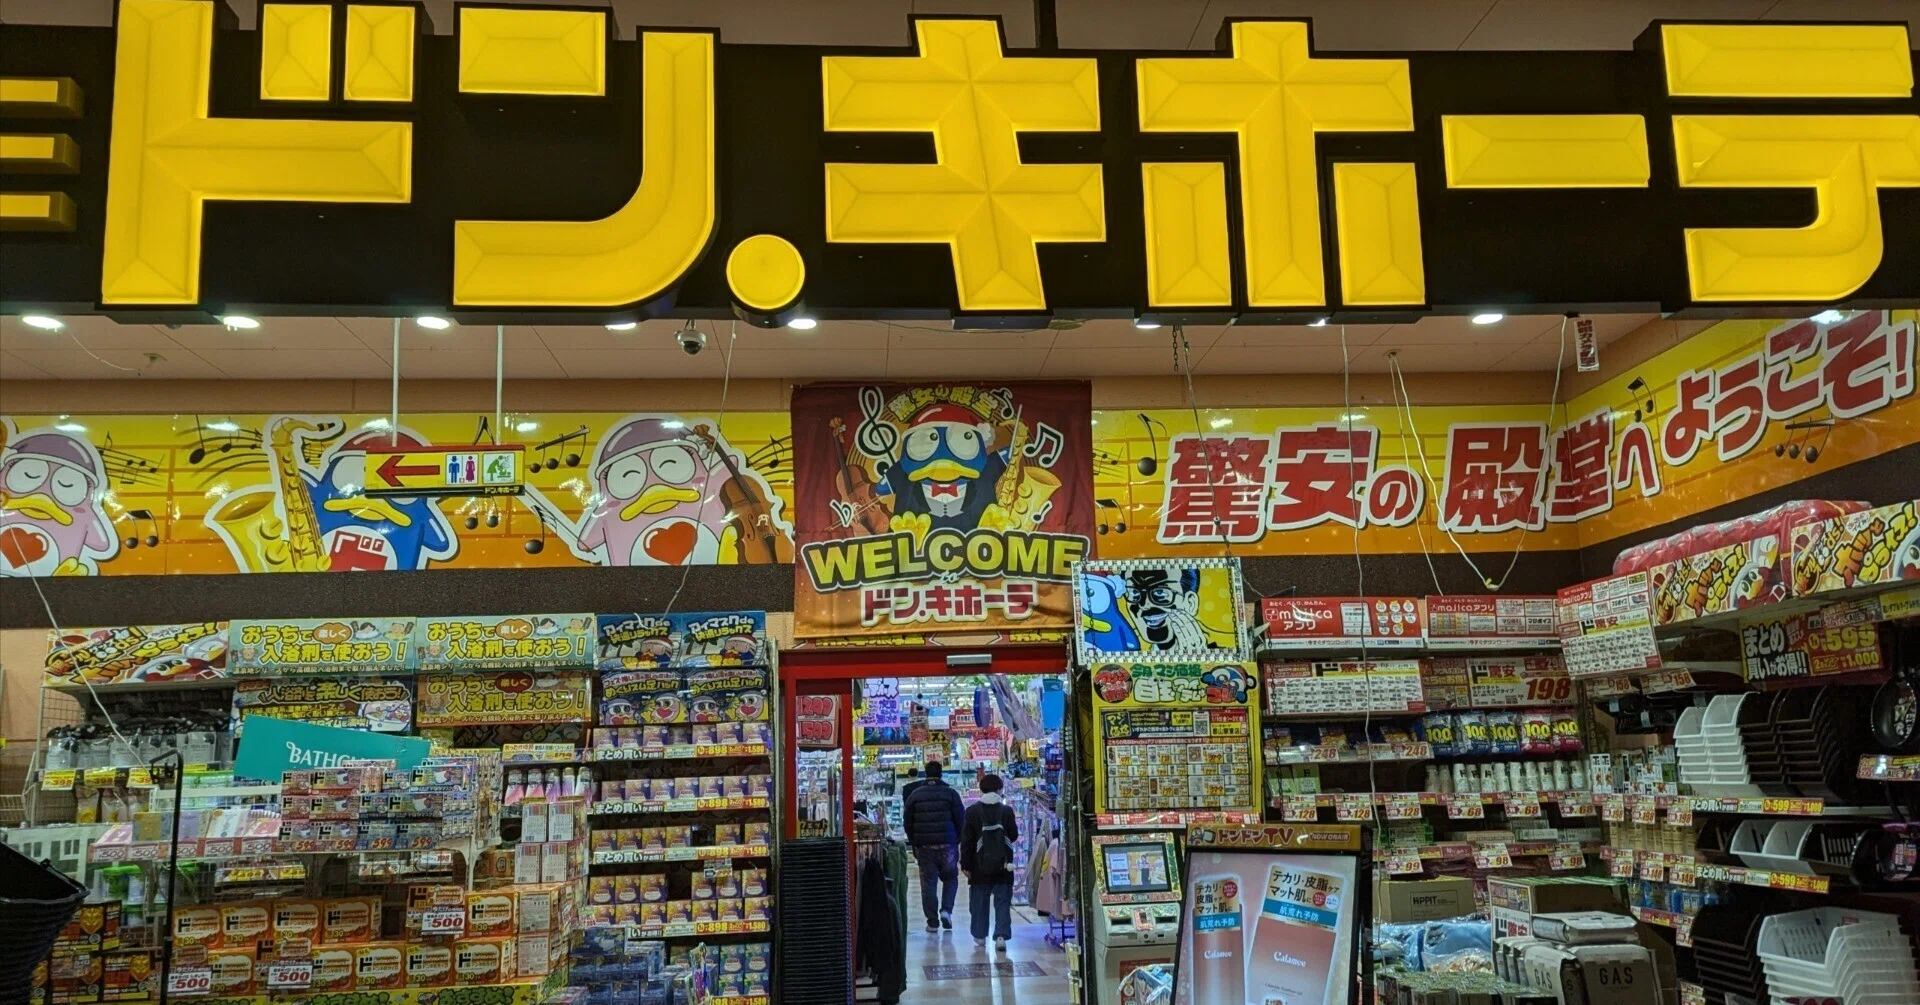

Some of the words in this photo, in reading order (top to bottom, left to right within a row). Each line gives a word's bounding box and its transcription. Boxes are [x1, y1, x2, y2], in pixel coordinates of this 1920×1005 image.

[808, 533, 1084, 585] WELCOME
[864, 583, 1034, 622] ドン.キホーテ
[1674, 673, 1691, 686] 158
[1526, 678, 1571, 701] 198
[1314, 748, 1337, 759] 248
[1404, 746, 1427, 756] 248
[1299, 811, 1315, 819] 128
[1354, 810, 1370, 819] 128
[1404, 809, 1420, 817] 128
[1218, 828, 1294, 844] ドンドンTV
[1279, 906, 1319, 921] 肌荒れ予防
[432, 917, 463, 928] 500
[1200, 917, 1236, 929] 肌荒れ予防
[278, 972, 310, 982] 500
[1534, 969, 1553, 989] GAS
[1600, 967, 1633, 985] GAS
[176, 979, 208, 989] 500
